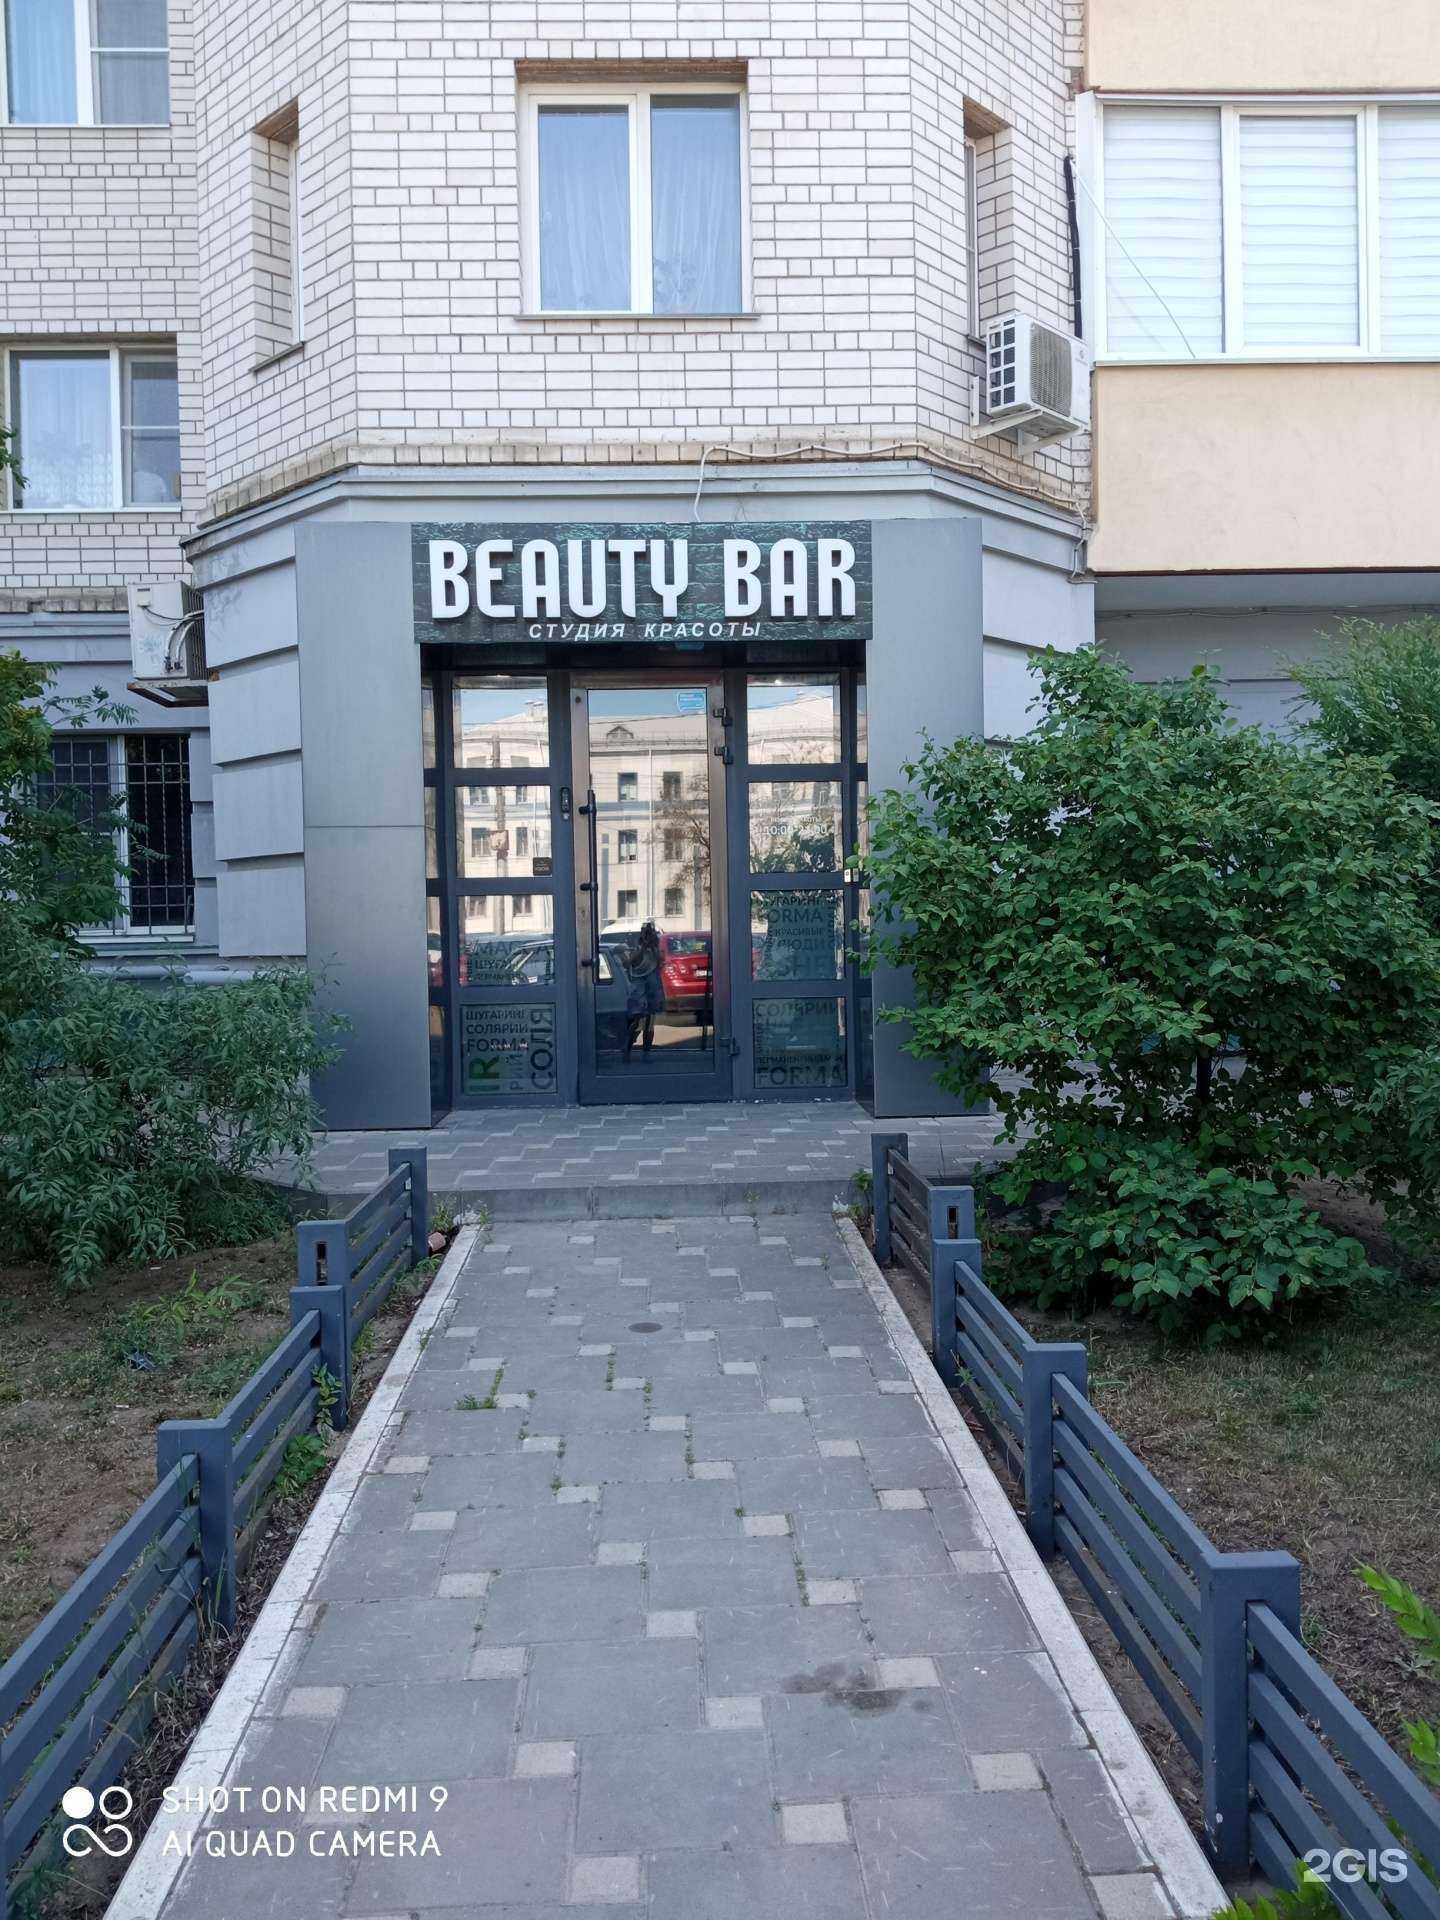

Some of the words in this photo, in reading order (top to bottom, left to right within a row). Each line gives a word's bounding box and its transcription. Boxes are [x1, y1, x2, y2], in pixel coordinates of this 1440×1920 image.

[429, 538, 688, 619] BEAUTY
[723, 537, 857, 618] BAR
[529, 623, 625, 641] СТУДИЯ
[644, 622, 761, 638] КРАСОТЫ
[760, 908, 823, 923] ORMA
[467, 1038, 529, 1052] FORMA
